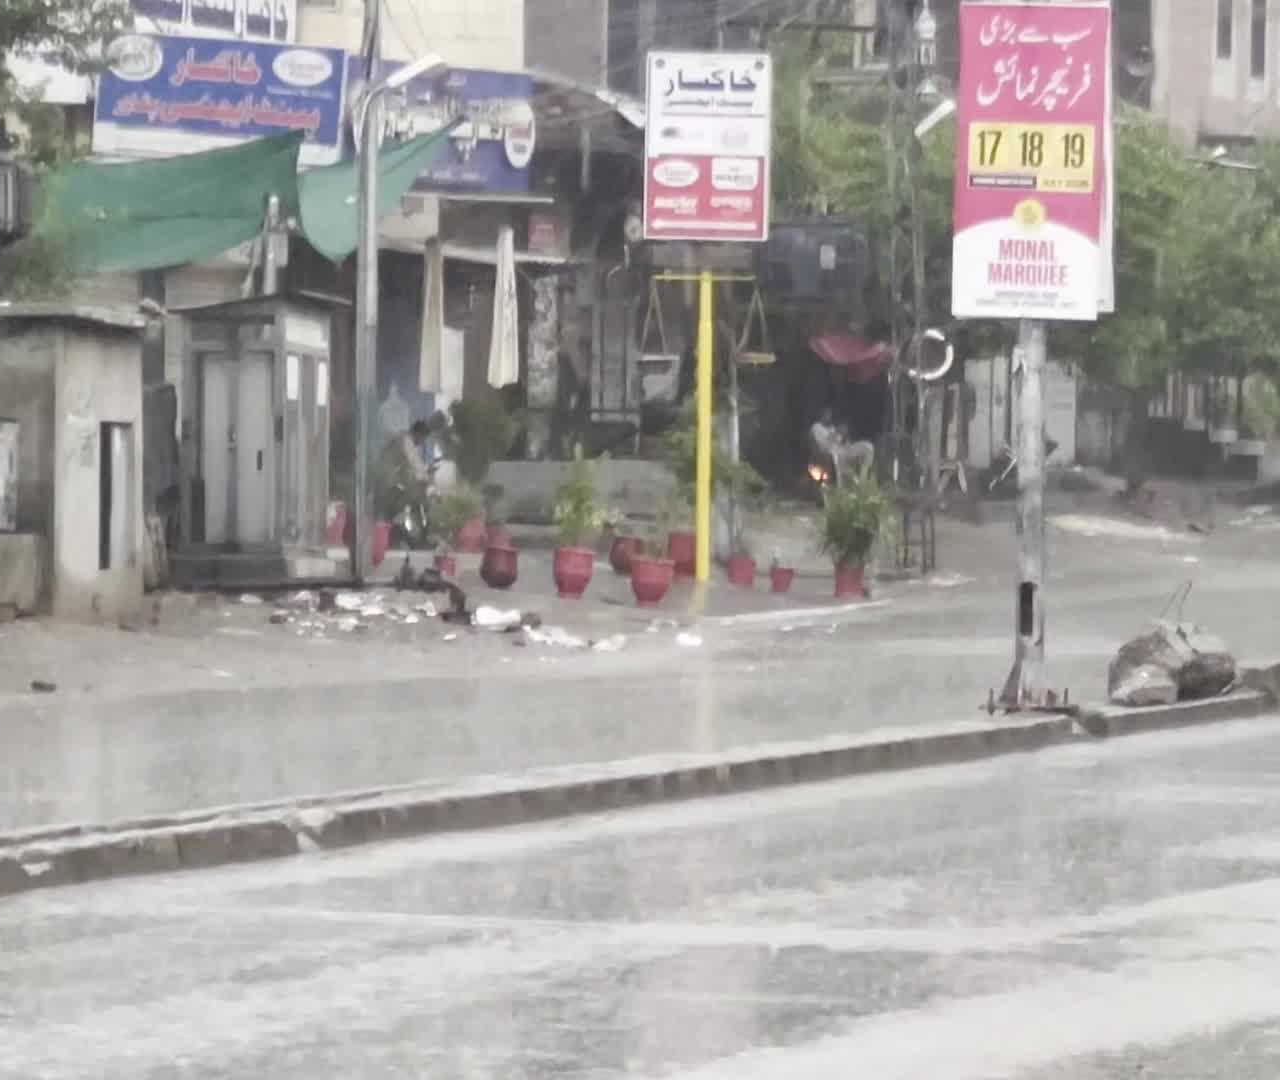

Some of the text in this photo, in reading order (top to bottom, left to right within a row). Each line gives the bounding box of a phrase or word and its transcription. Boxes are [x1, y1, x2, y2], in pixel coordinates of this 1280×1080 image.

[979, 12, 1094, 51] سب سے بڑی
[663, 67, 757, 97] خاکسار
[976, 50, 1092, 112] فرنیچر نمائش
[977, 130, 1086, 169] 17 18 19
[998, 239, 1056, 262] MONAL
[986, 263, 1070, 287] MARQUEE
